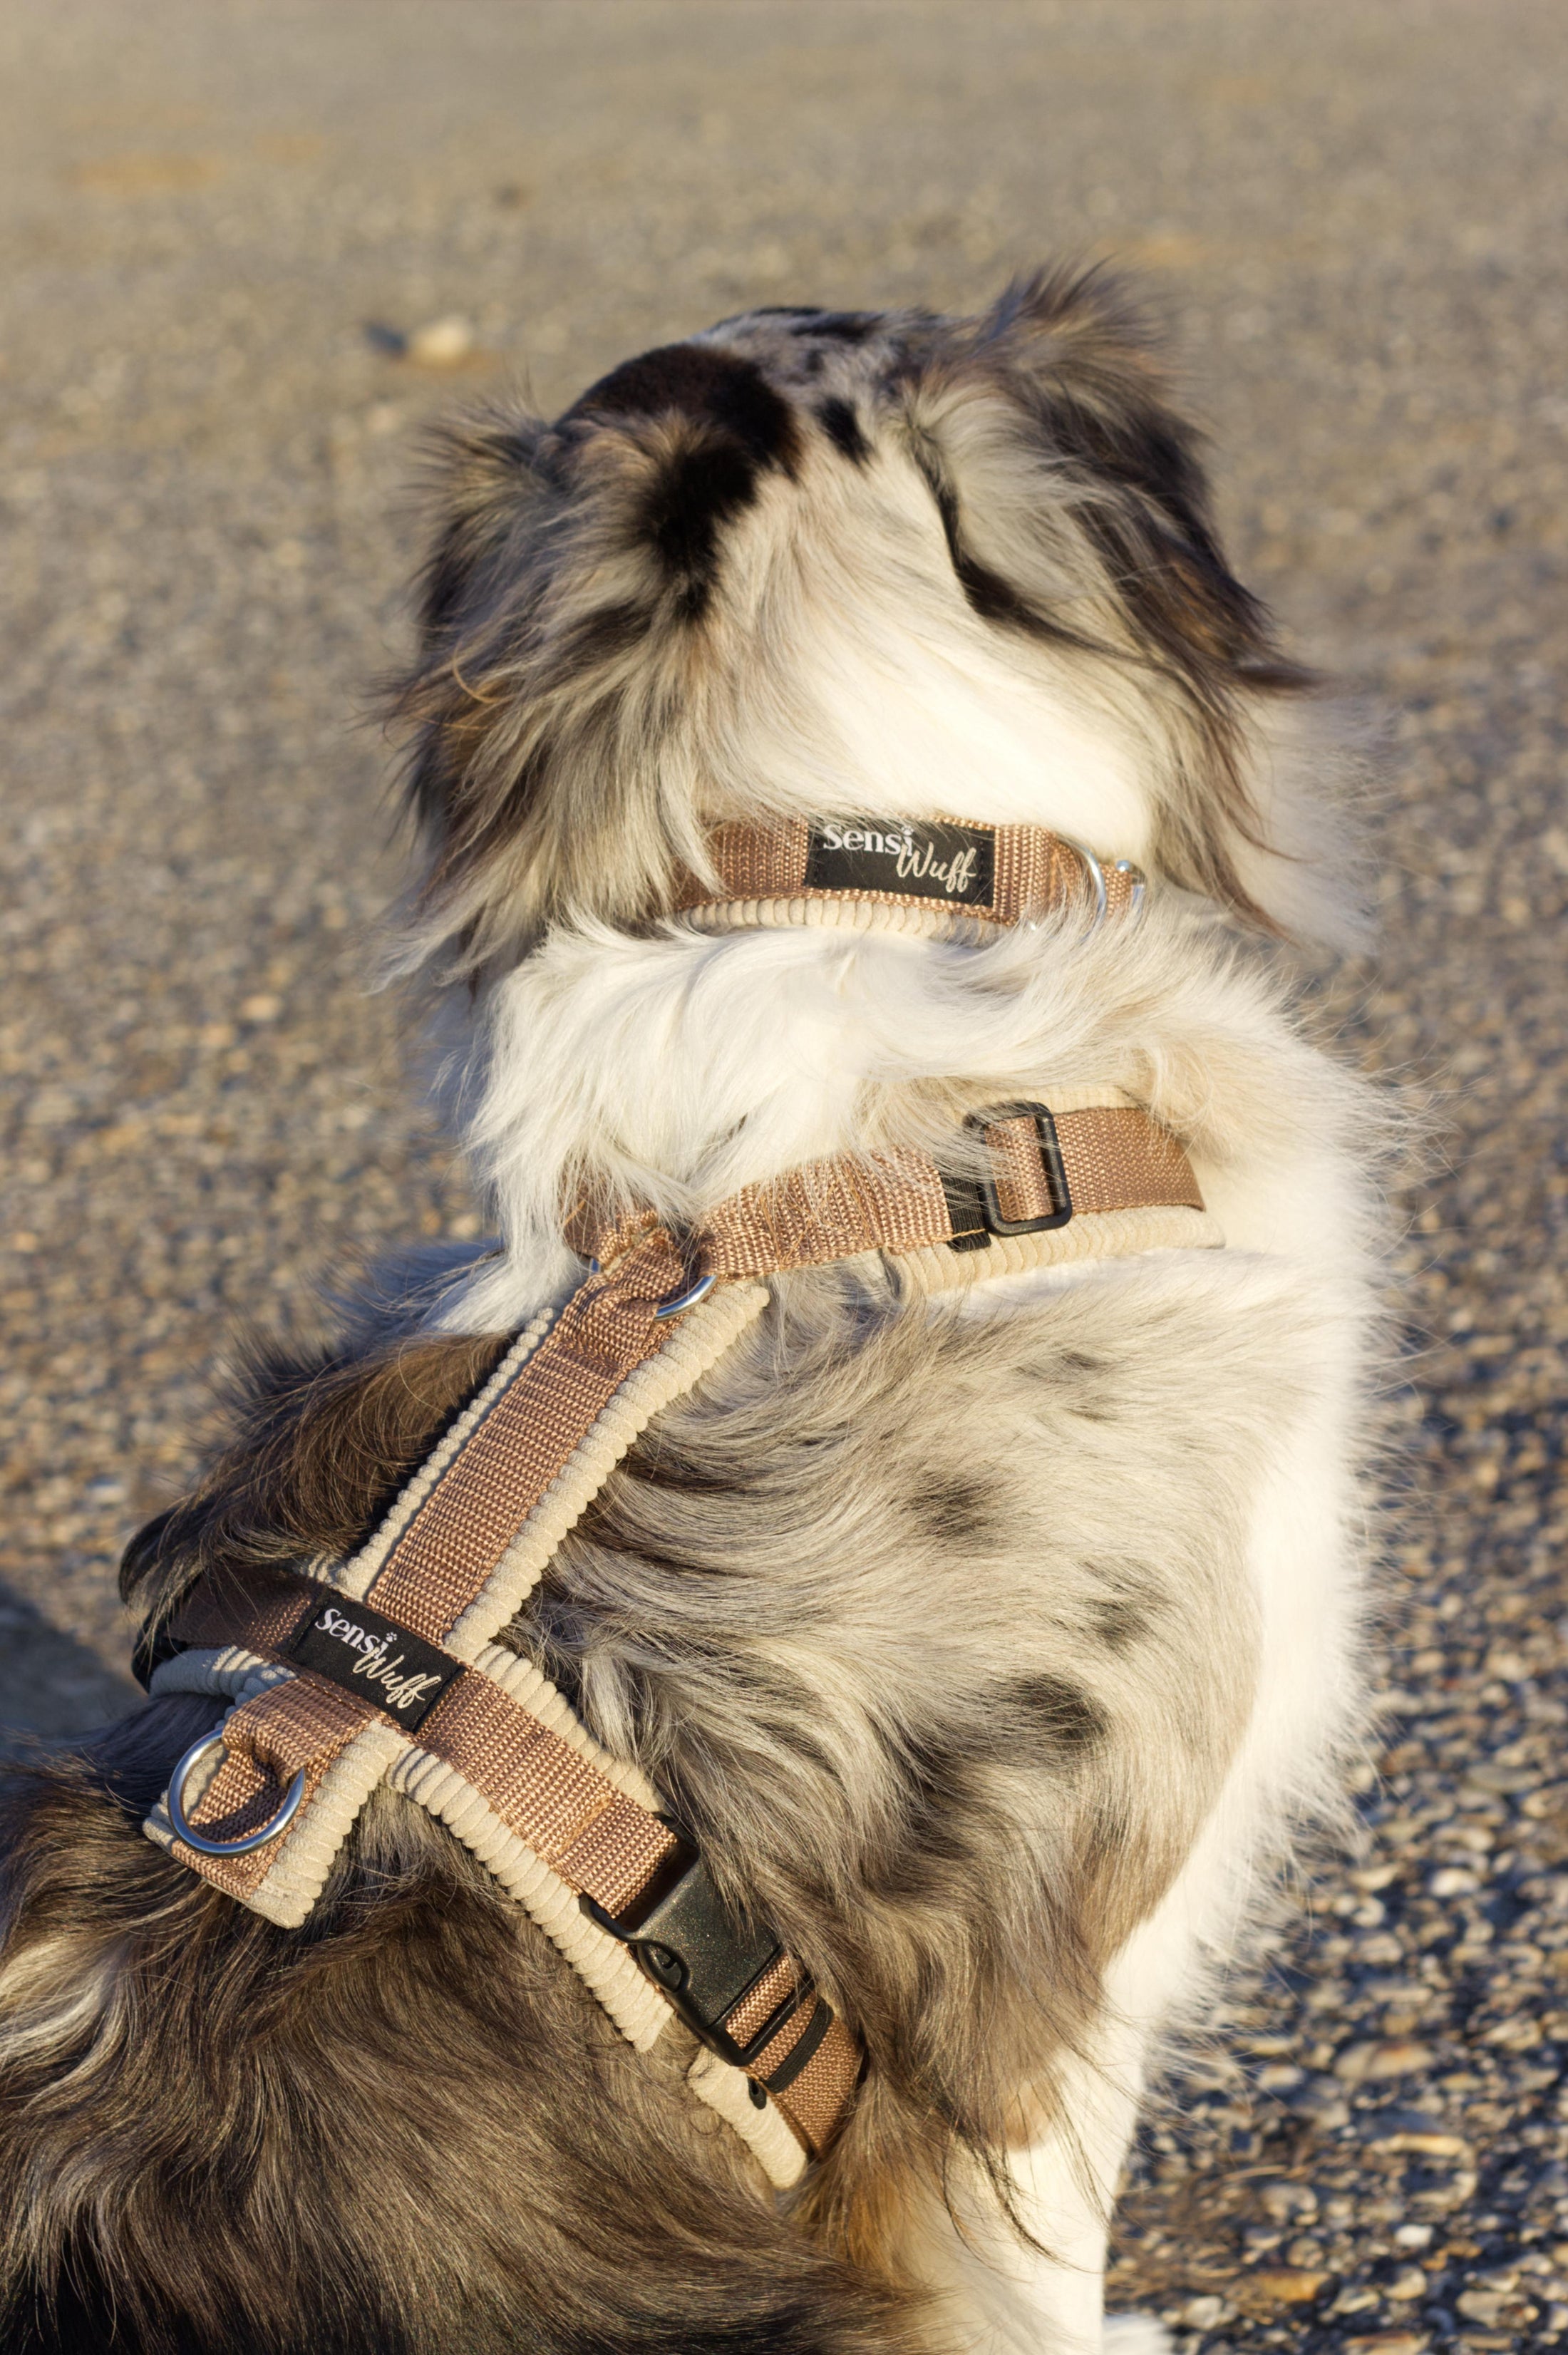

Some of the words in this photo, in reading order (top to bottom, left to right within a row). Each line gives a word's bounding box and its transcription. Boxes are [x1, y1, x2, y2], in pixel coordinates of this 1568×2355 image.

[823, 825, 914, 857] Sensi
[896, 841, 976, 892] Wuff
[315, 1609, 397, 1659] Sensi
[352, 1647, 442, 1709] Wuff
